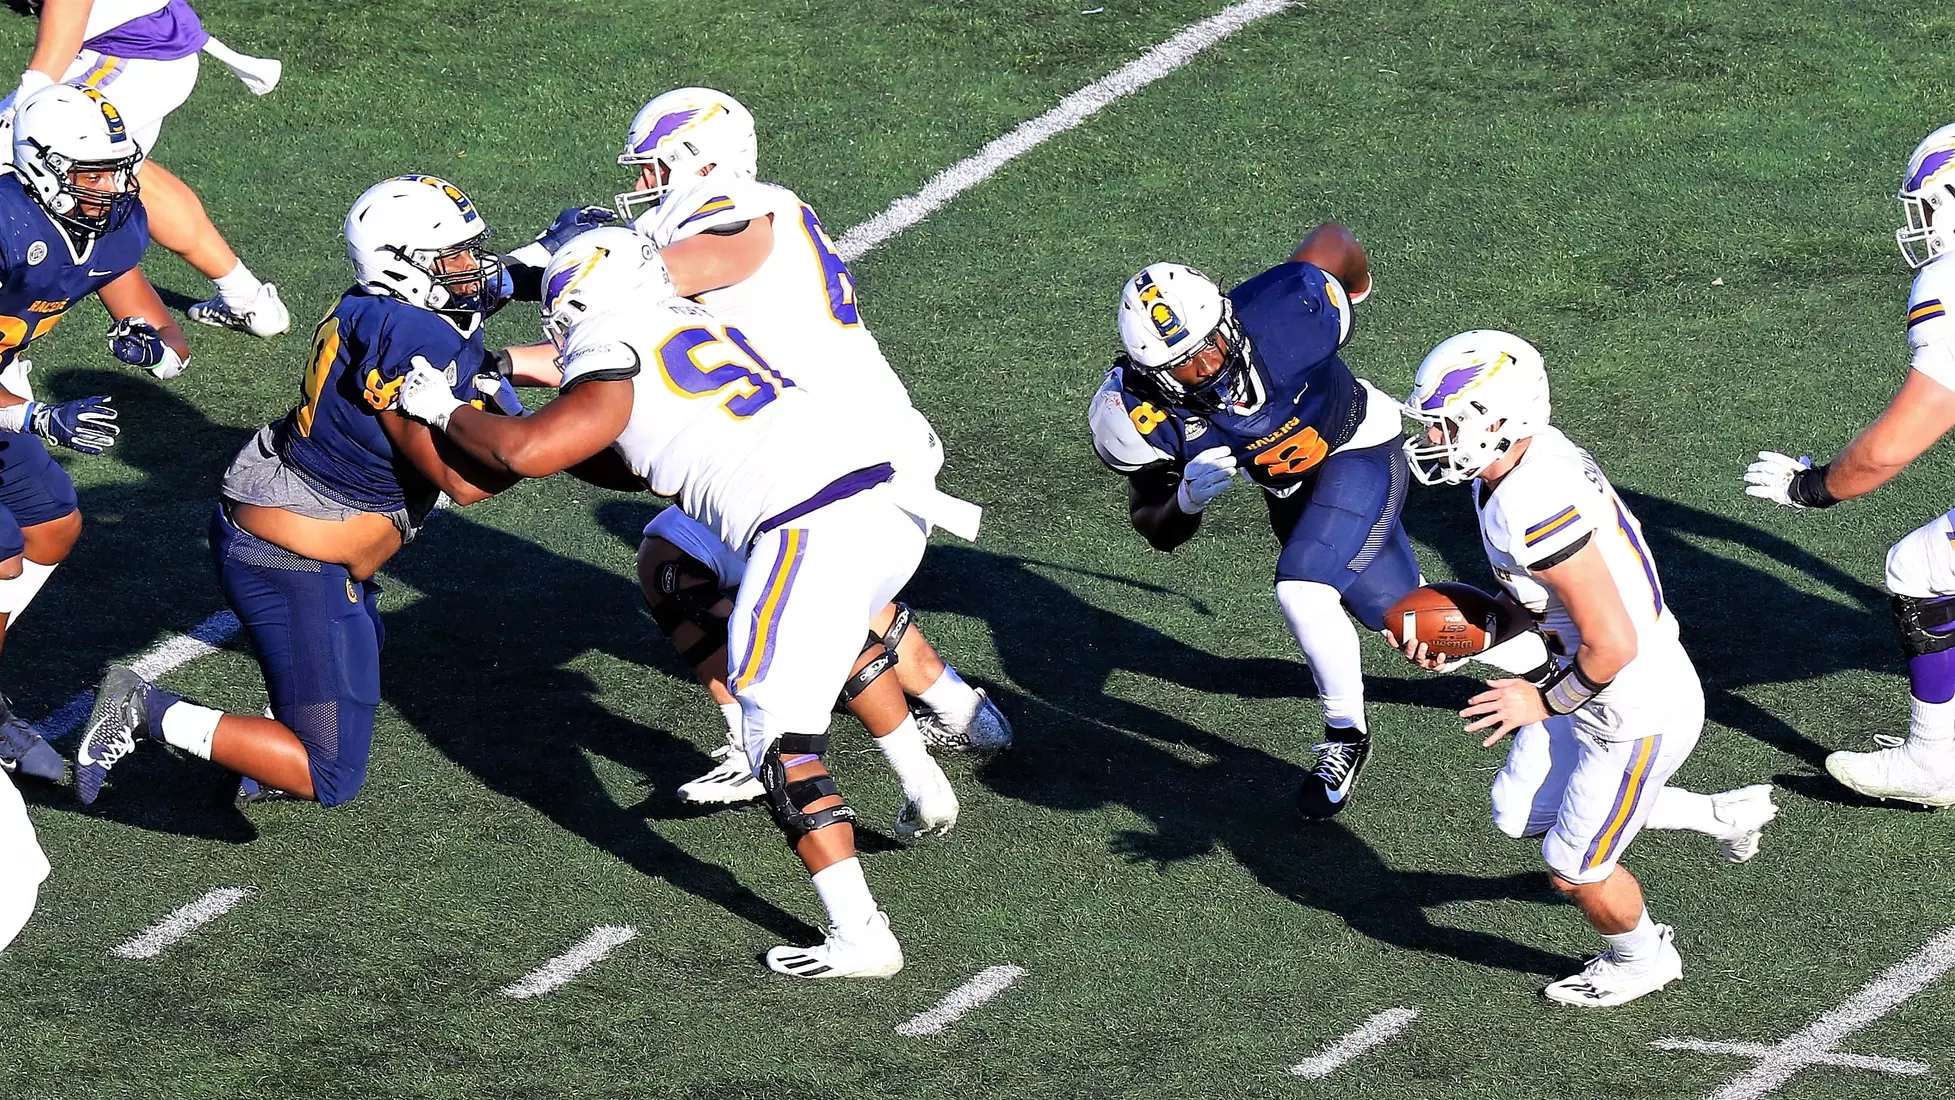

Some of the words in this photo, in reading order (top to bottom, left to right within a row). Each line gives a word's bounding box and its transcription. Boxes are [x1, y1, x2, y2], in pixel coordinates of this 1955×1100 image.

[1129, 401, 1167, 435] 8
[1245, 416, 1300, 451] RACERS
[1254, 425, 1329, 477] 8
[1431, 640, 1474, 649] Wilson
